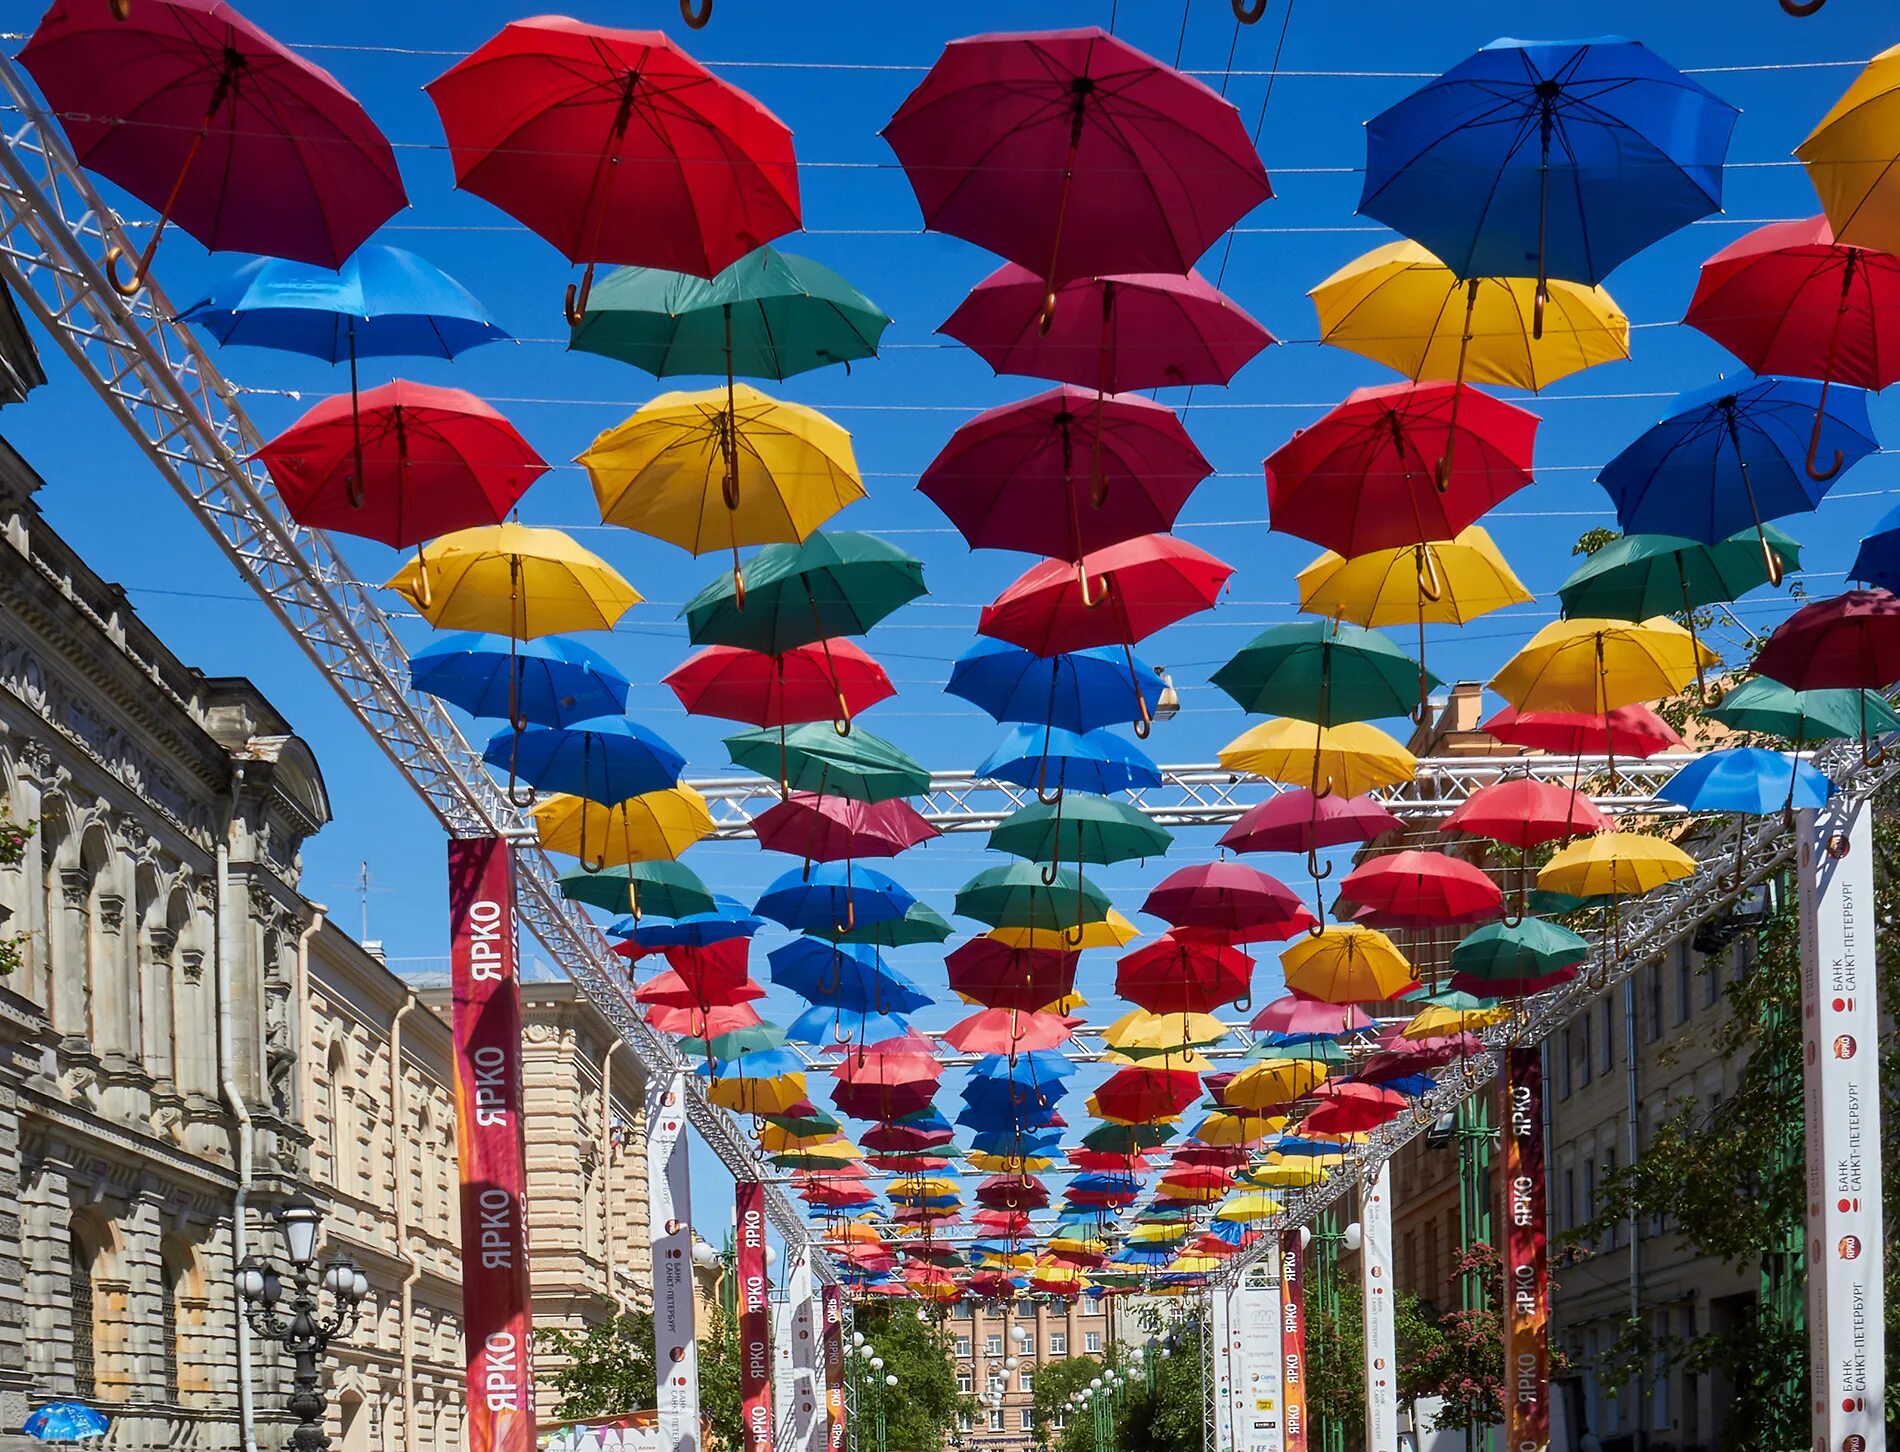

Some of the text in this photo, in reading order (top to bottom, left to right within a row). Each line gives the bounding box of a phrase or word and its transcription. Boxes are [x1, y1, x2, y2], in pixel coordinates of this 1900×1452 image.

[470, 900, 501, 981] ЯРКО
[1842, 881, 1857, 991] САНКТ-ПЕТЕРБУРГ
[1832, 958, 1843, 991] БАНК
[1840, 1036, 1850, 1058] ЯРКО
[475, 1046, 507, 1127] ЯРКО
[1512, 1086, 1531, 1137] ЯРКО
[1848, 1082, 1861, 1192] САНКТ-ПЕТЕРБУРГ
[1838, 1159, 1848, 1192] БАНК
[1513, 1176, 1533, 1227] ЯРКО
[480, 1189, 512, 1269] ЯРКО
[744, 1210, 761, 1248] ЯРКО
[1283, 1252, 1296, 1281] ЯРКО
[1846, 1238, 1856, 1259] ЯРКО
[674, 1262, 682, 1284] БАНК
[1515, 1264, 1535, 1316] ЯРКО
[665, 1262, 676, 1333] САНКТ-ПЕТЕРБУРГ
[747, 1276, 764, 1314] ЯРКО
[827, 1298, 837, 1324] ЯРКО
[1284, 1303, 1297, 1334] ЯРКО
[1853, 1282, 1865, 1391] САНКТ-ПЕТЕРБУРГ
[750, 1341, 765, 1378] ЯРКО
[829, 1340, 839, 1365] ЯРКО
[1286, 1353, 1299, 1384] ЯРКО
[485, 1331, 518, 1412] ЯРКО
[1517, 1353, 1536, 1402] ЯРКО
[1843, 1360, 1853, 1391] БАНК
[831, 1382, 840, 1407] ЯРКО
[751, 1406, 767, 1444] ЯРКО
[833, 1423, 842, 1448] ЯРКО
[1287, 1404, 1300, 1435] ЯРКО
